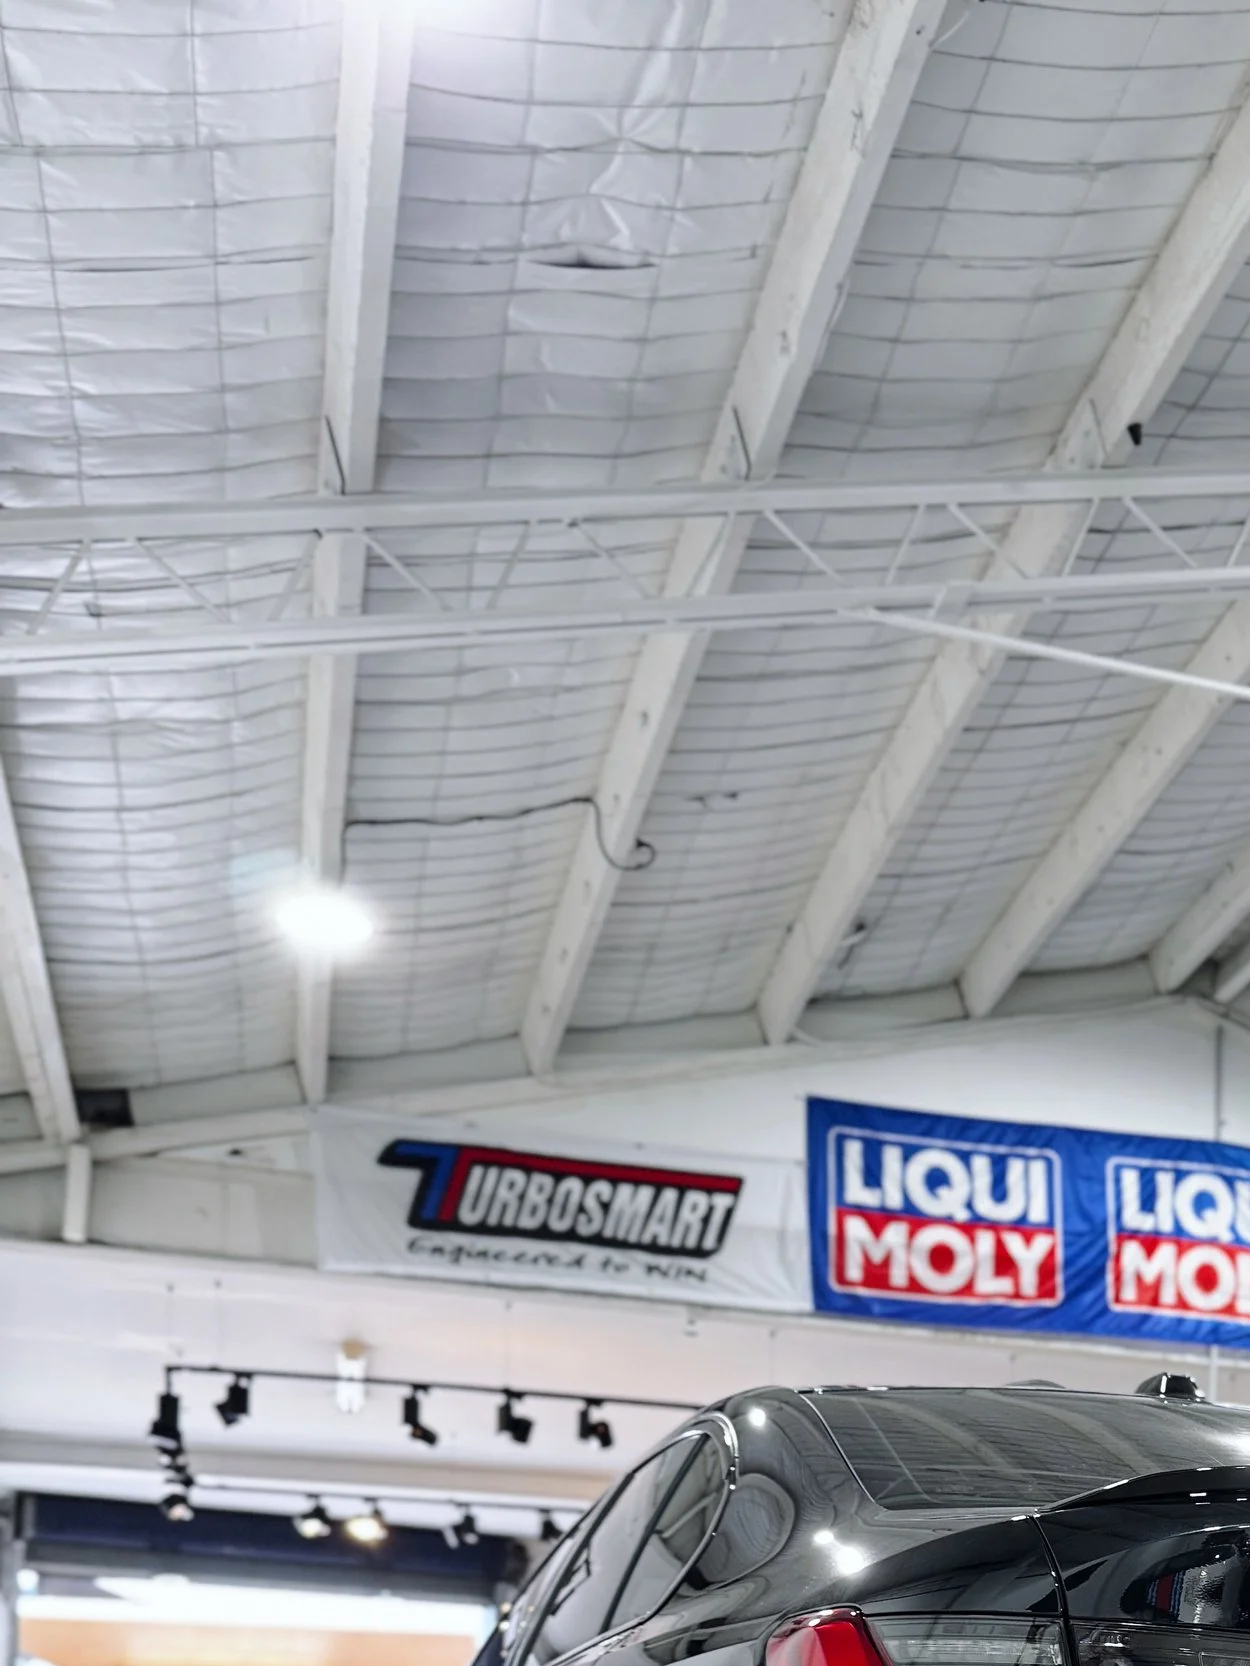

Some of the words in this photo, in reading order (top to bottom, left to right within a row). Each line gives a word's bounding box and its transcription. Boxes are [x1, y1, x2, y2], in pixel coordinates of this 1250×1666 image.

[378, 1138, 743, 1254] TURBOSMART
[843, 1138, 1049, 1223] LIQUI
[600, 1254, 630, 1273] to
[645, 1261, 707, 1282] WIN
[843, 1214, 1055, 1299] MOLY
